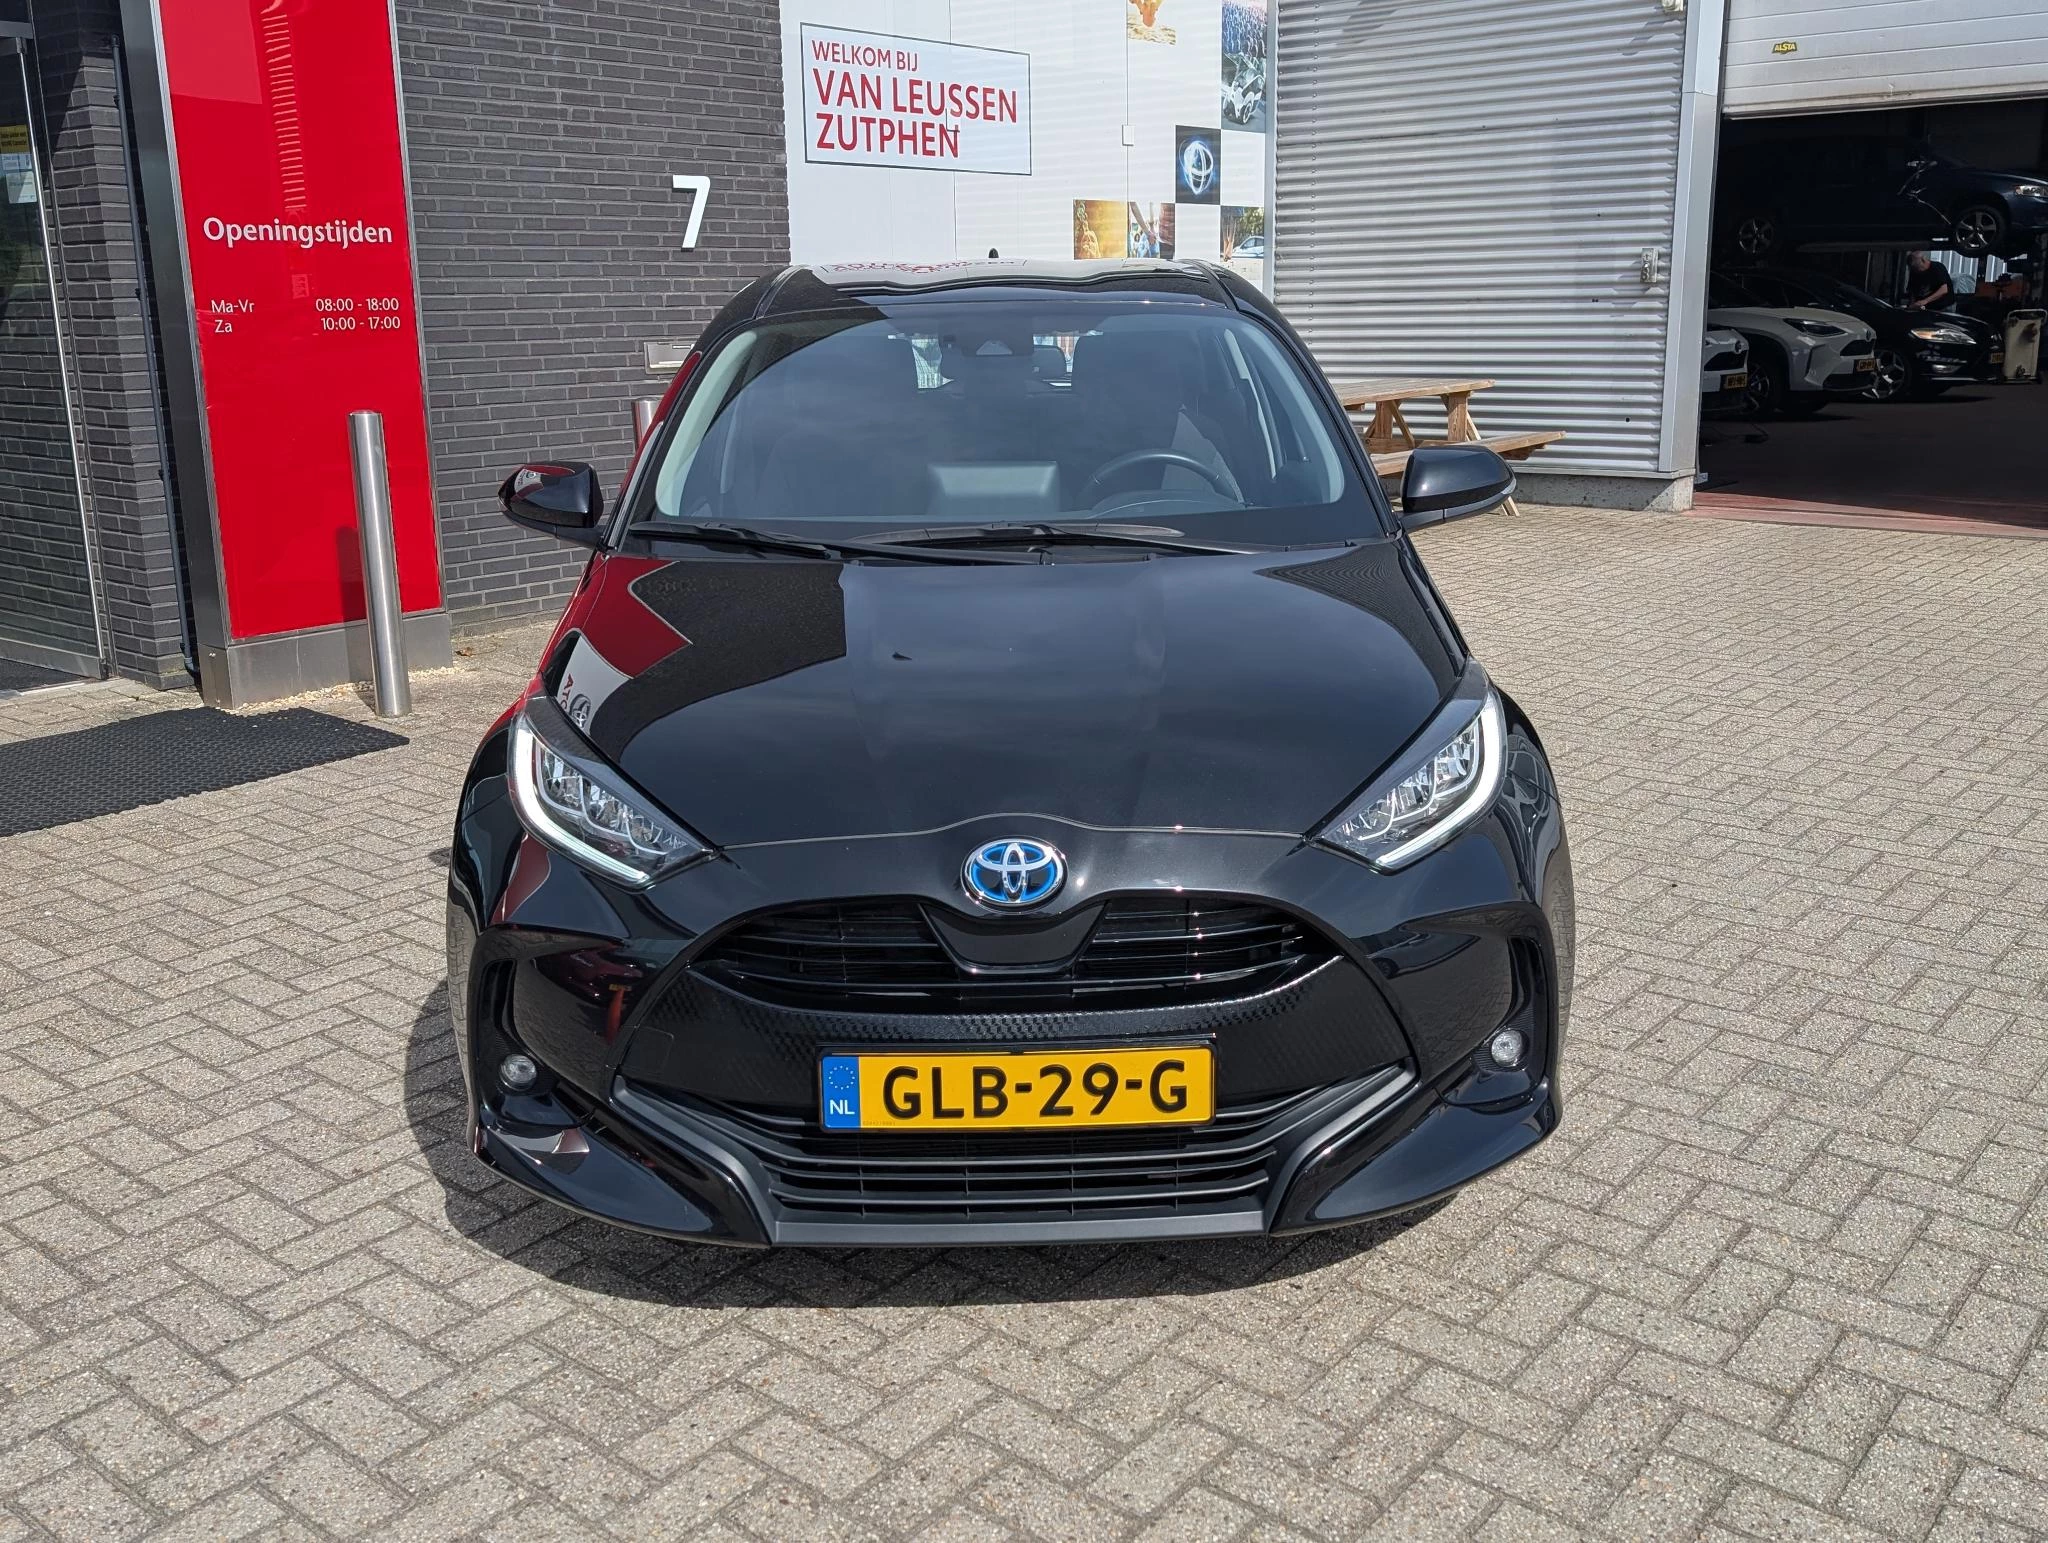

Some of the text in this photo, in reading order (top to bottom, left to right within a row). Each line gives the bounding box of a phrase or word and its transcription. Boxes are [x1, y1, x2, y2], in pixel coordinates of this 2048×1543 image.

[811, 39, 918, 72] WELKOM BIJ
[1774, 42, 1796, 51] ALSTA
[812, 67, 1017, 123] VAN LEUSSEN
[816, 112, 959, 158] ZUTPHEN
[672, 174, 711, 252] 7
[203, 216, 393, 249] Openingstijden
[211, 299, 255, 314] Ma-Vr
[315, 298, 354, 312] 08:00
[365, 297, 399, 311] 18:00
[214, 319, 233, 333] Za
[320, 317, 356, 331] 10:00
[367, 316, 401, 330] 17:00
[882, 1059, 1188, 1120] GLB-29-G
[829, 1099, 856, 1115] NL
